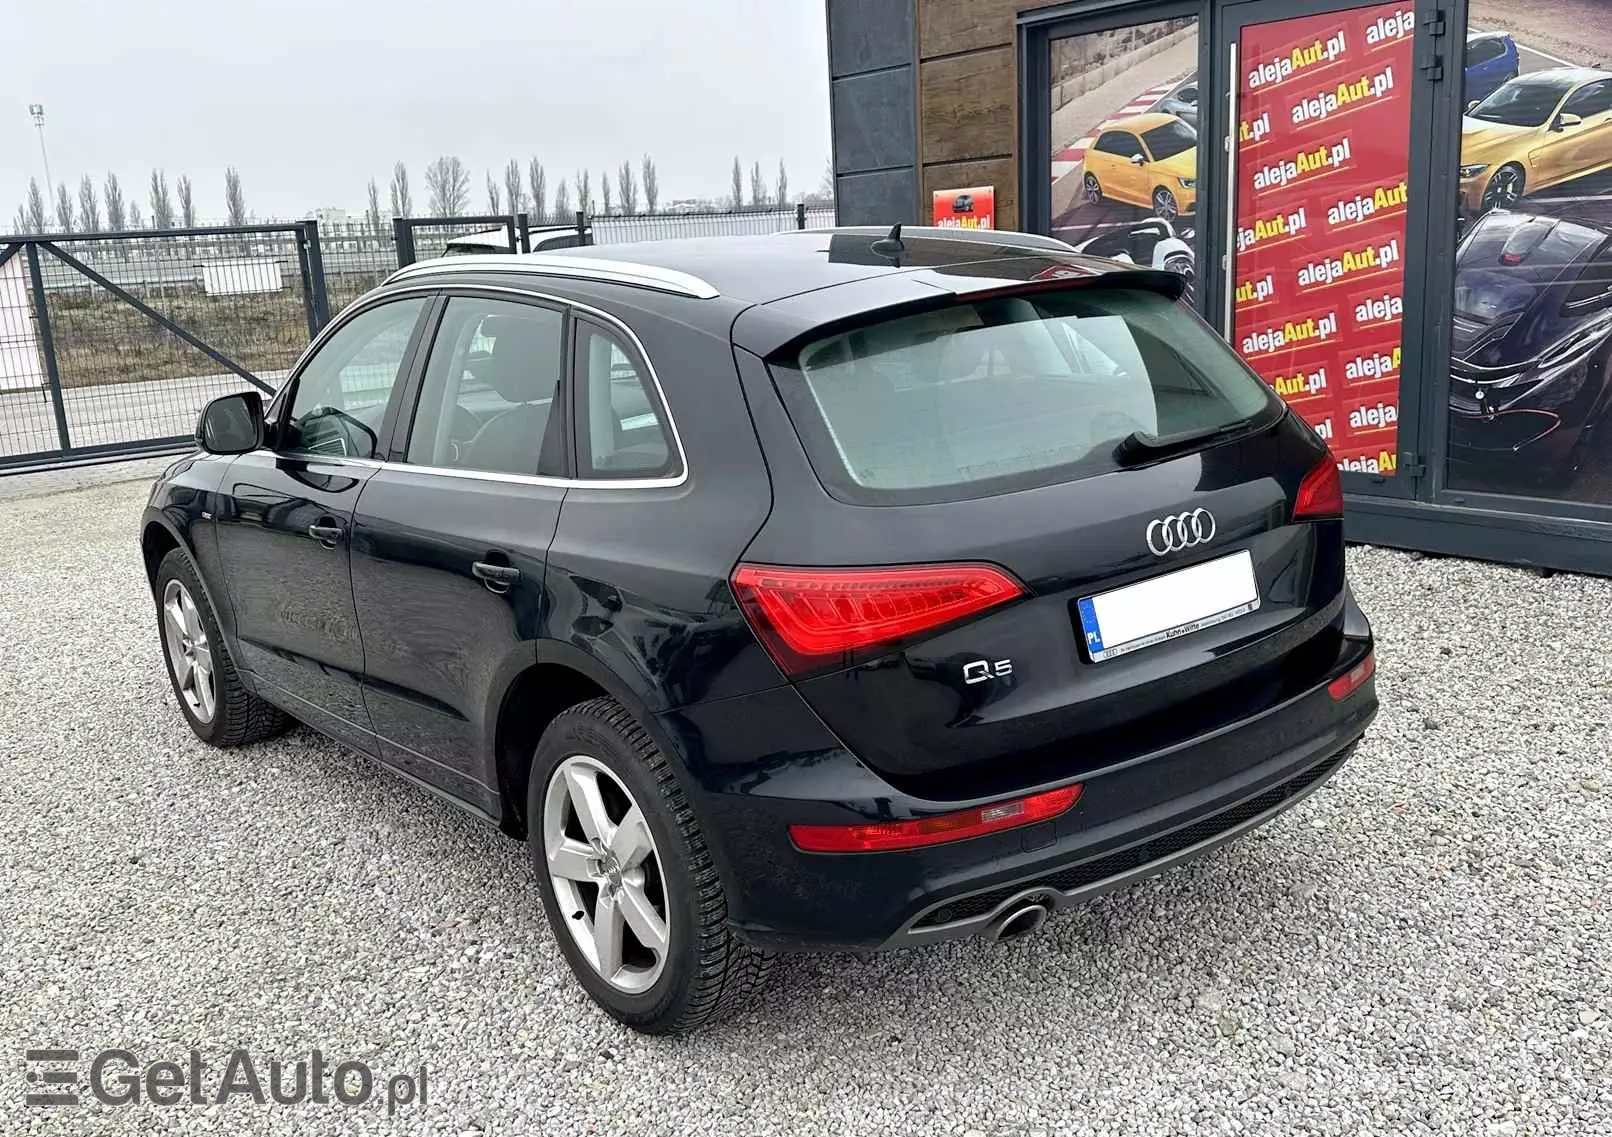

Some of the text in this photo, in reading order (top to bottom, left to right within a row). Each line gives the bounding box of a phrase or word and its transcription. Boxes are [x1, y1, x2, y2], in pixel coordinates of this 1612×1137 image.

[1365, 9, 1414, 44] aleja
[1248, 30, 1346, 89] alejaAut.pl
[1291, 66, 1394, 123] alejaAut.pl
[1253, 138, 1351, 190] alejaAut.pl
[1327, 183, 1408, 225] alejaAut
[1297, 240, 1399, 287] alejaAut.pl
[1355, 294, 1402, 322] aleja
[1242, 312, 1336, 354] alejaAut.pl
[1349, 403, 1398, 429] aleja
[1087, 631, 1101, 645] PL
[963, 659, 1013, 684] Q5
